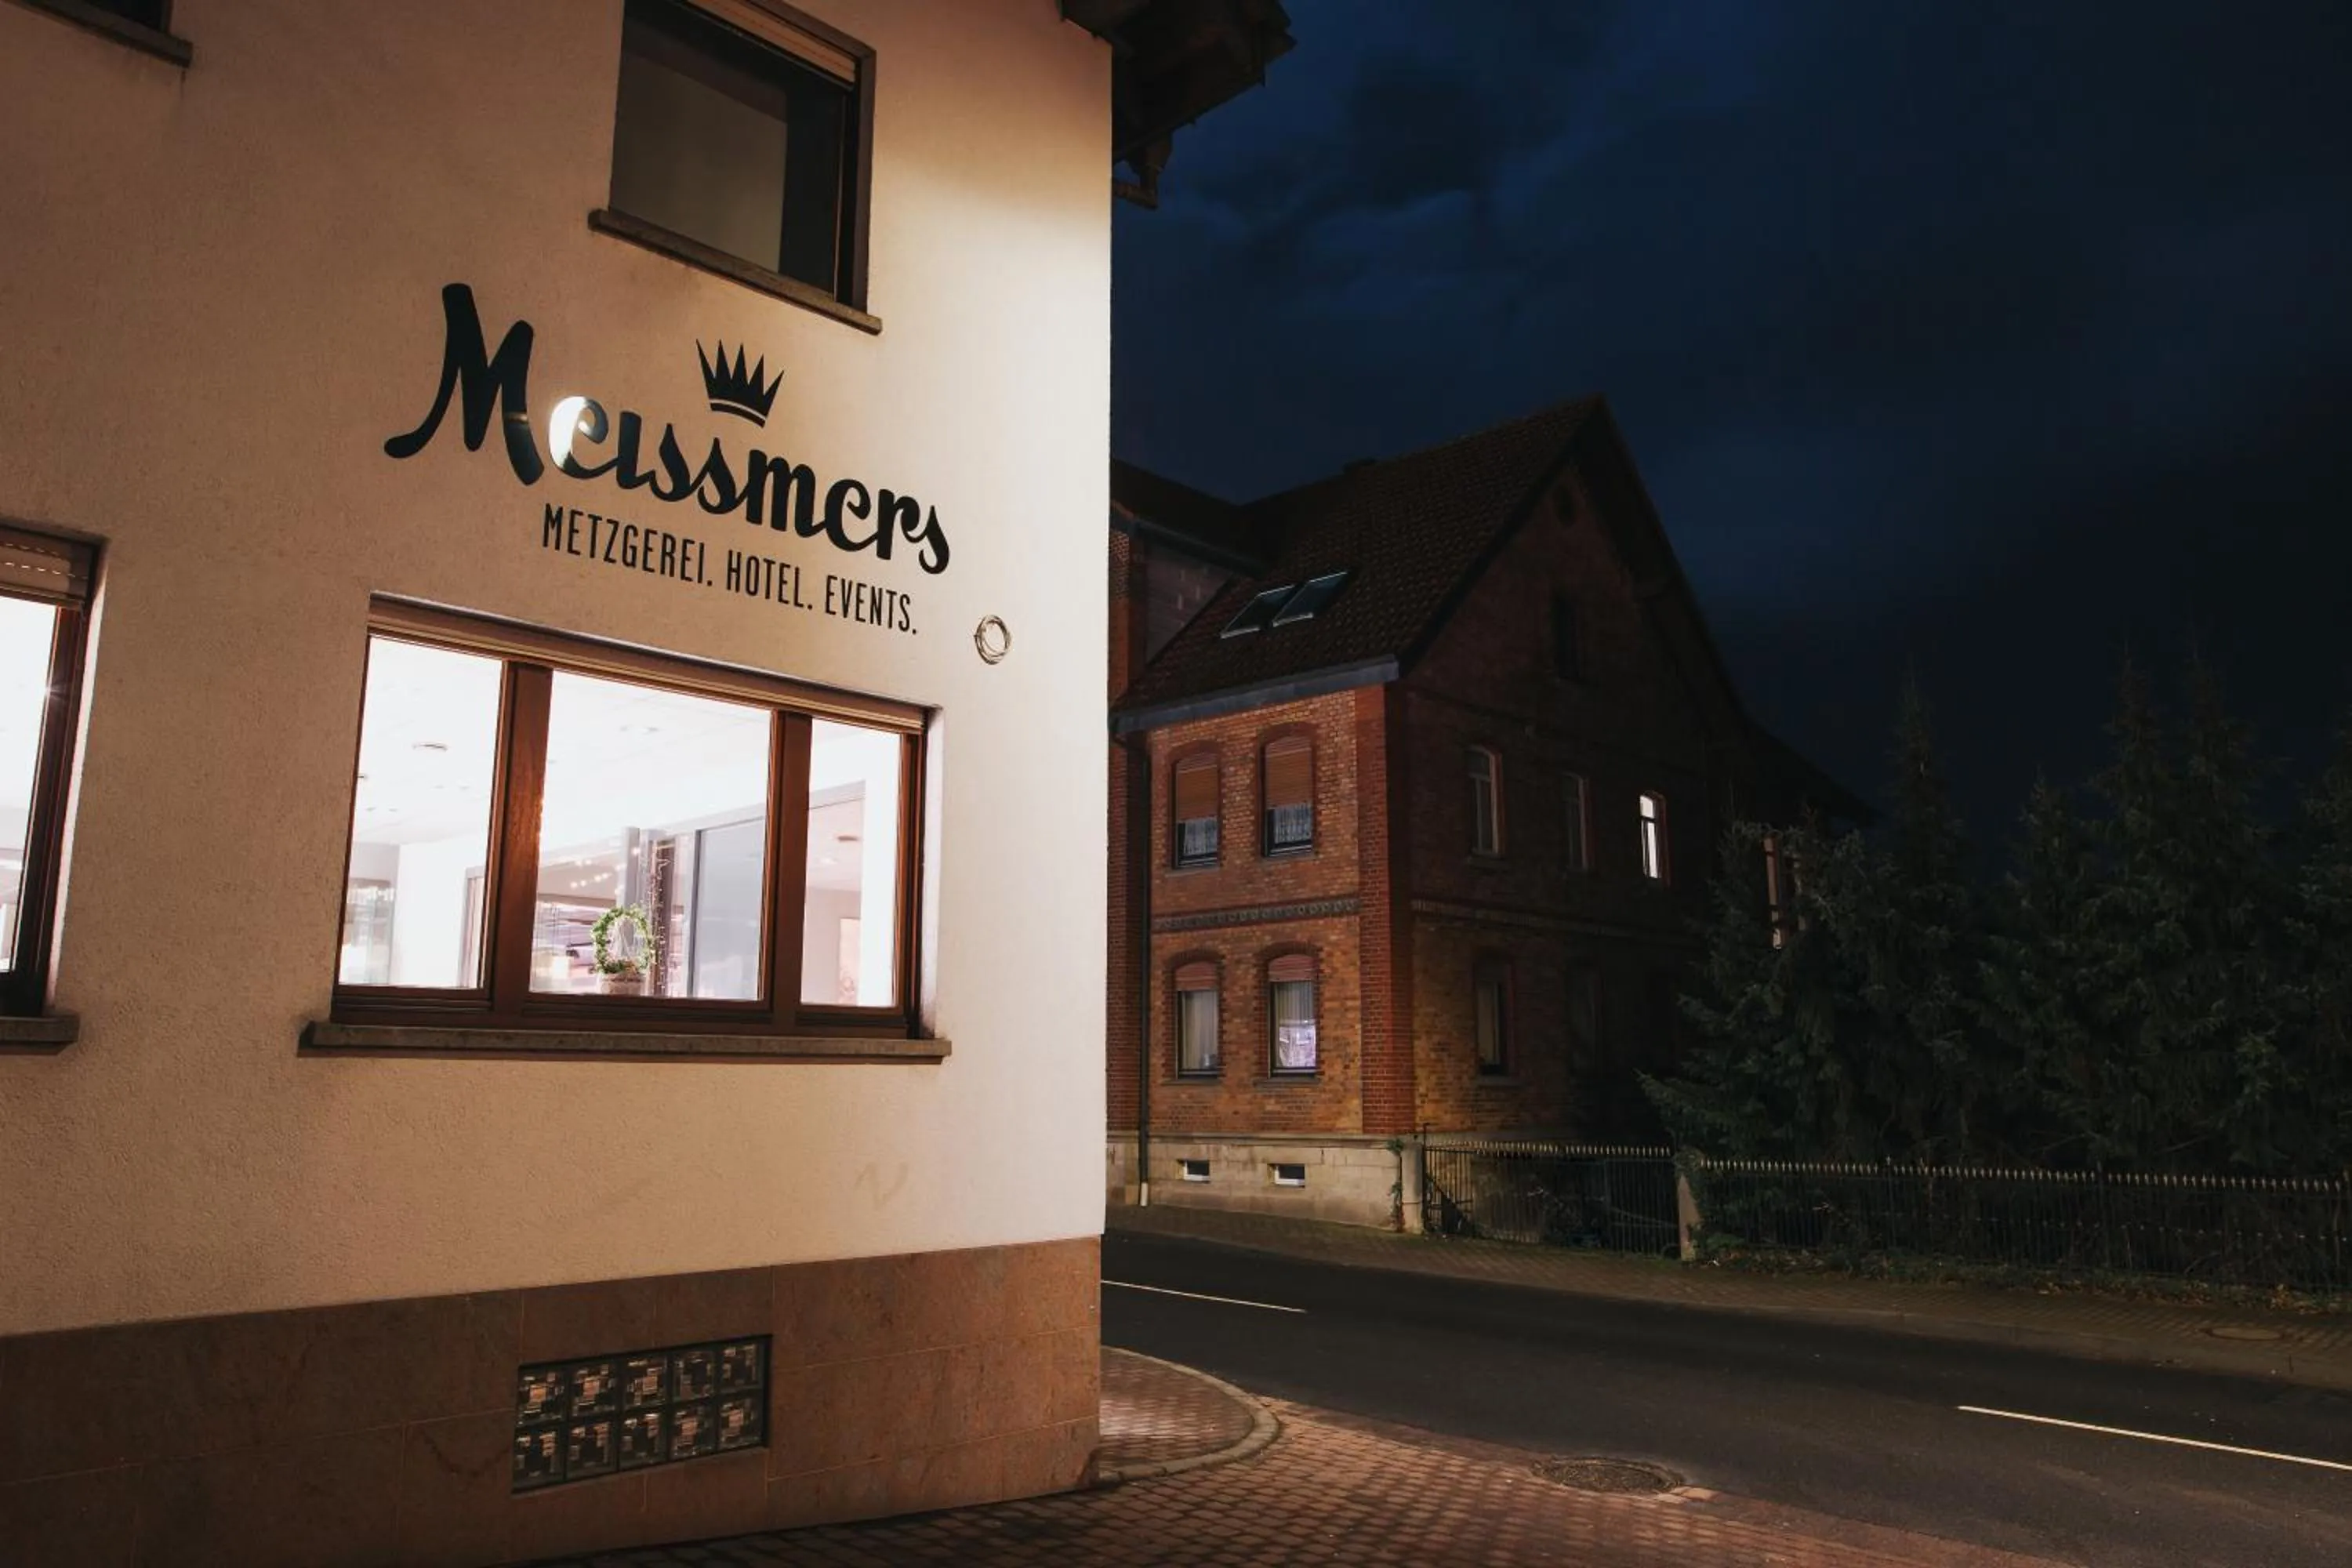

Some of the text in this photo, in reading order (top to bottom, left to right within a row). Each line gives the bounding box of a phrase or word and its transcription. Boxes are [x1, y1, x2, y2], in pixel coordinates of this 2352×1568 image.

[383, 282, 950, 574] Meissmers
[543, 503, 916, 634] METZGEREI. HOTEL. EVENTS.
